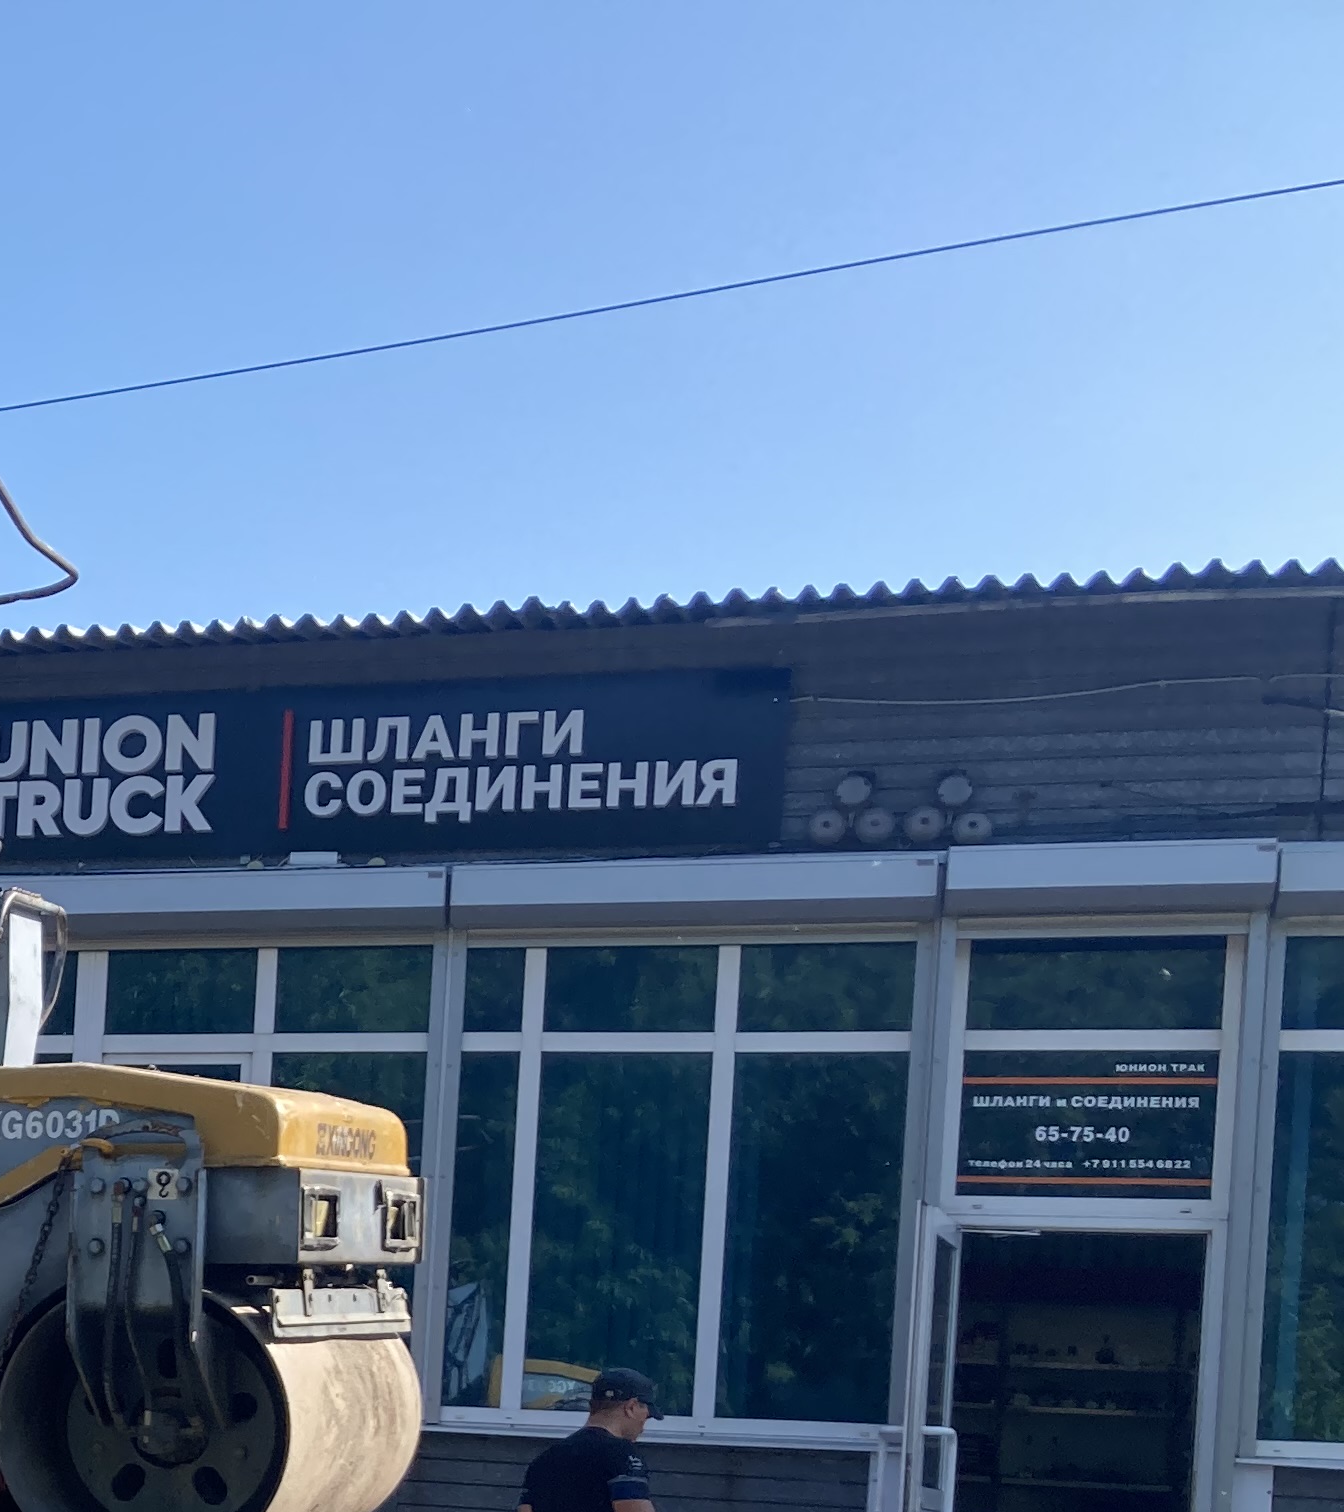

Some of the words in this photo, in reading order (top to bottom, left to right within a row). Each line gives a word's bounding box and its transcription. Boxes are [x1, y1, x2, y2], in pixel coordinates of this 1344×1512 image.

[308, 709, 584, 764] ШЛАНГИ
[304, 758, 738, 824] СОЕДИНЕНИЯ
[1115, 1063, 1166, 1073] ЮНИОН
[1170, 1063, 1205, 1073] ТРАК
[972, 1095, 1051, 1108] ШЛАНГИ
[1070, 1095, 1200, 1109] СОЕДИНЕНИЯ
[1034, 1125, 1130, 1142] 65-75-40
